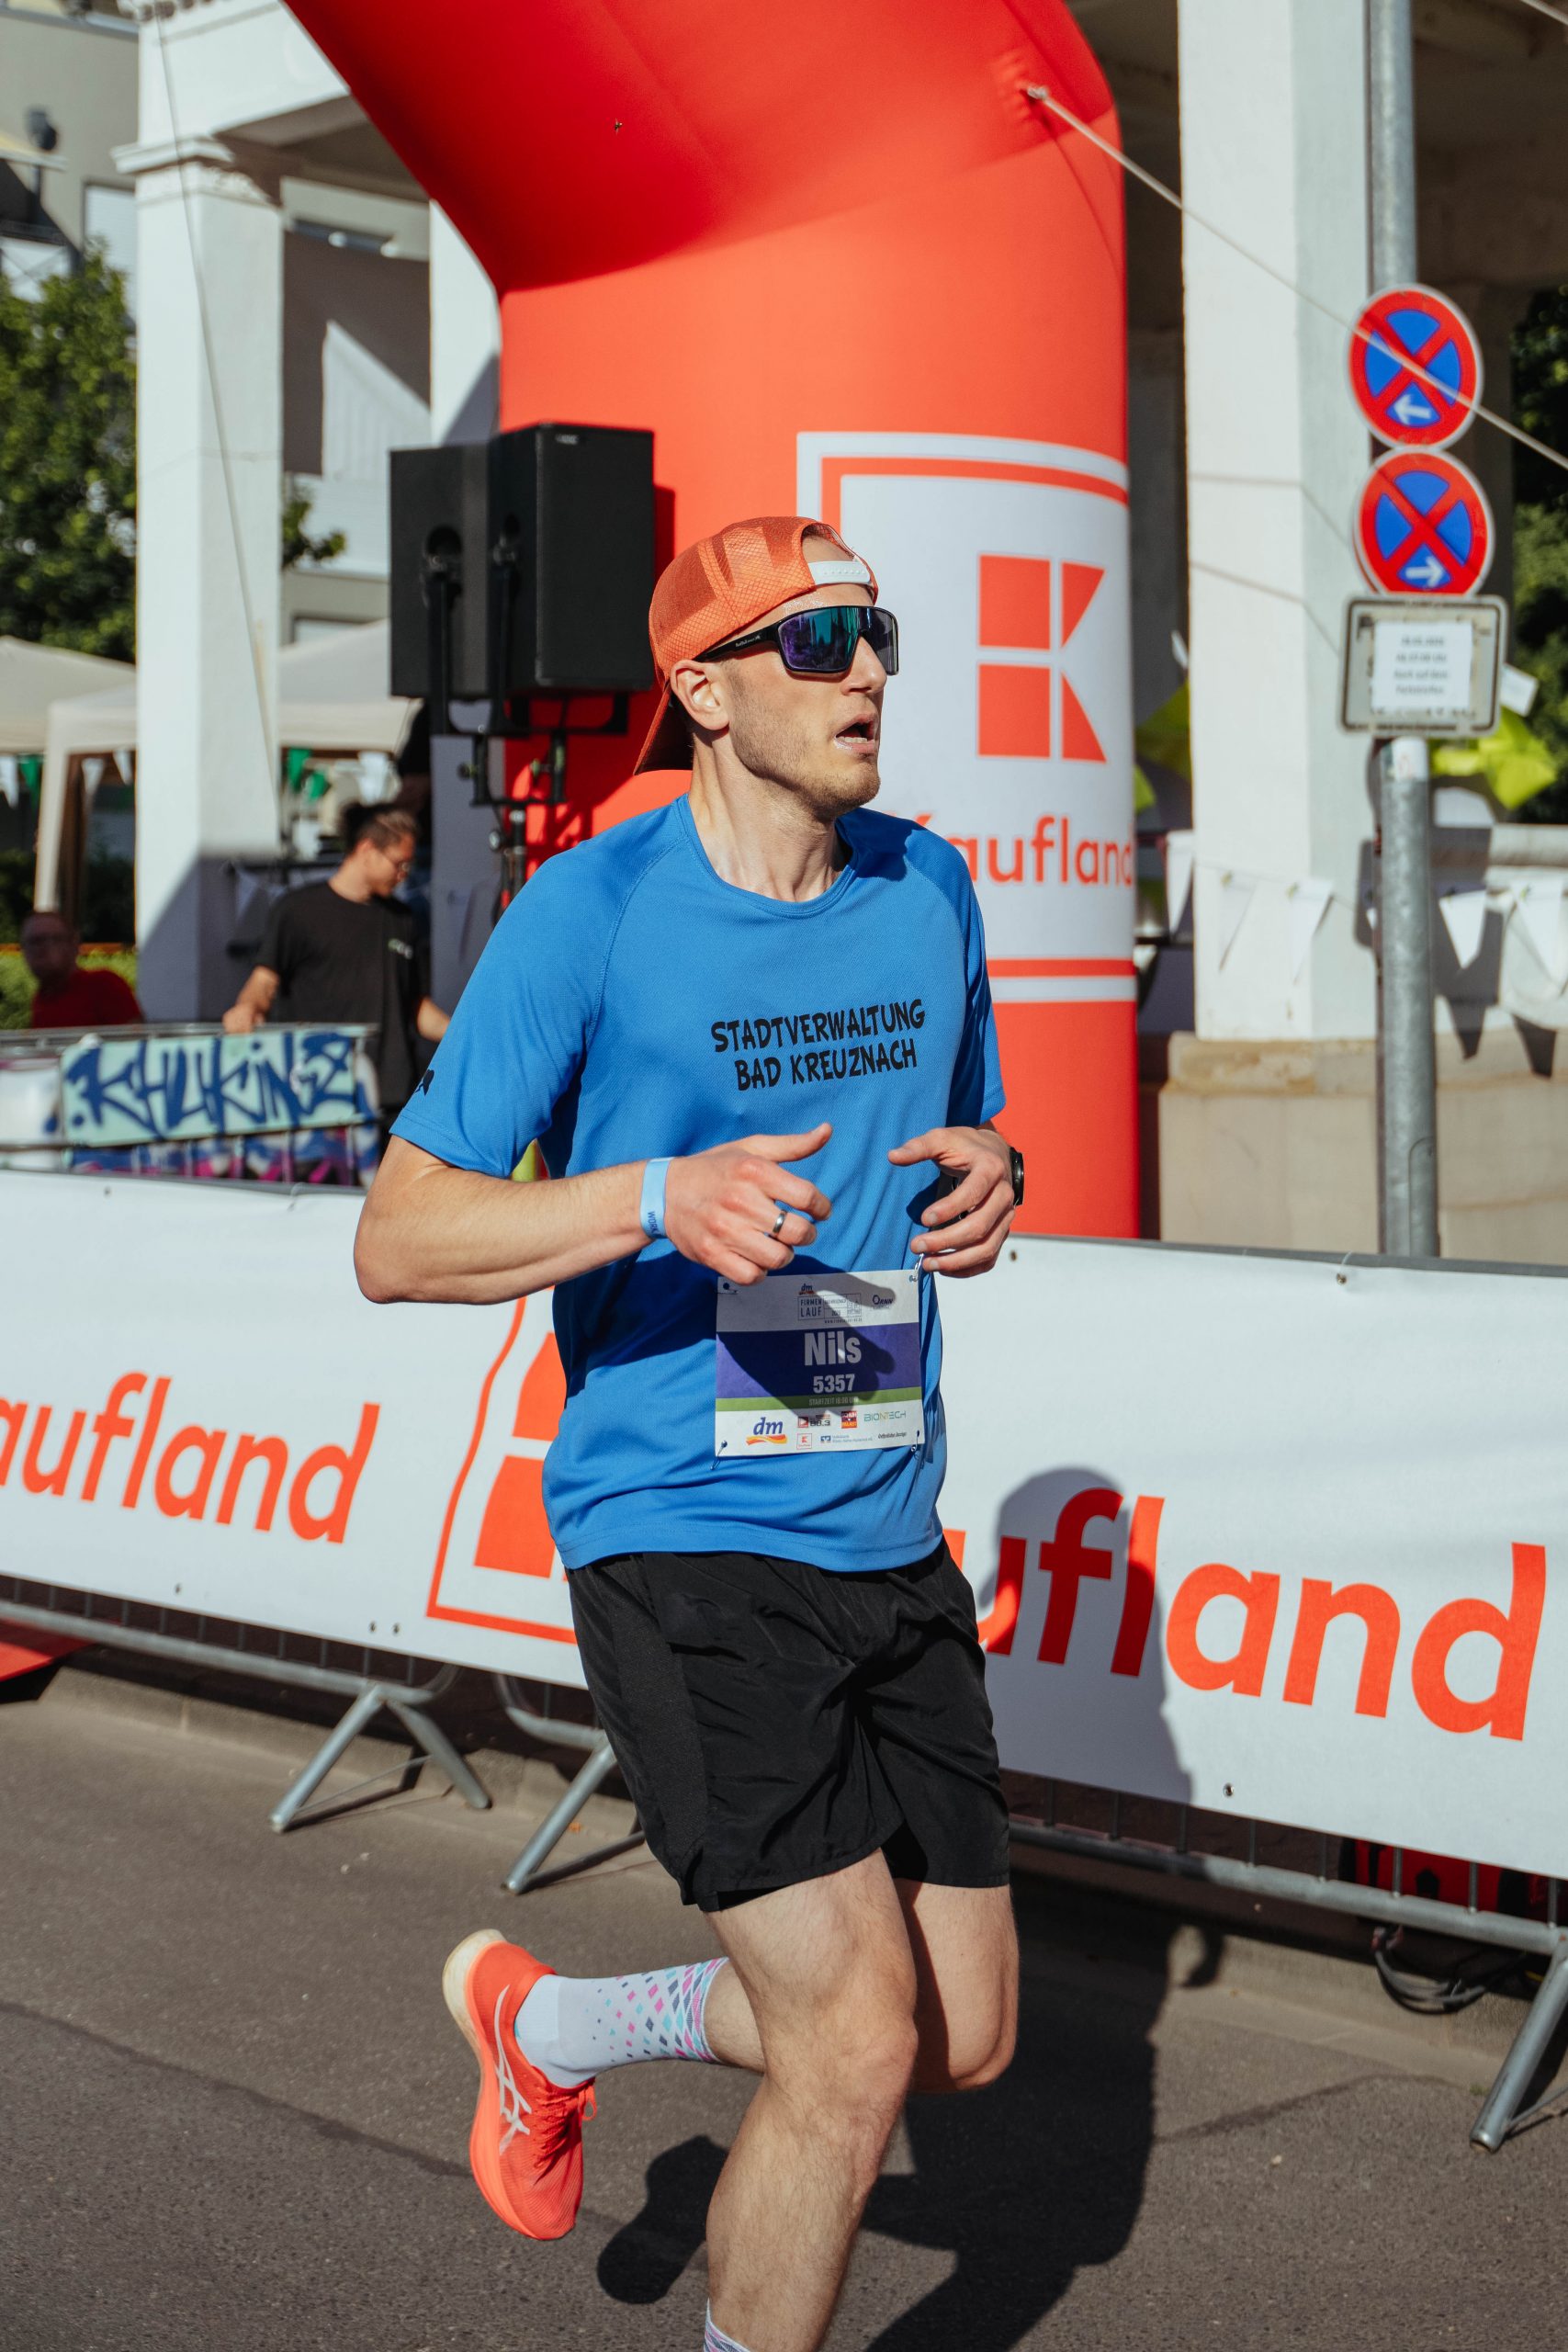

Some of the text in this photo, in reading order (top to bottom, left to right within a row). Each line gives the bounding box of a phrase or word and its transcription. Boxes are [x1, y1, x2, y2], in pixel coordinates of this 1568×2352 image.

[711, 999, 925, 1053] STADTVERWALTUNG
[735, 1038, 918, 1091] BAD KREUZNACH
[800, 1306, 822, 1317] LAUF
[804, 1330, 862, 1366] Nils
[813, 1374, 855, 1394] 5357
[753, 1417, 783, 1435] dm
